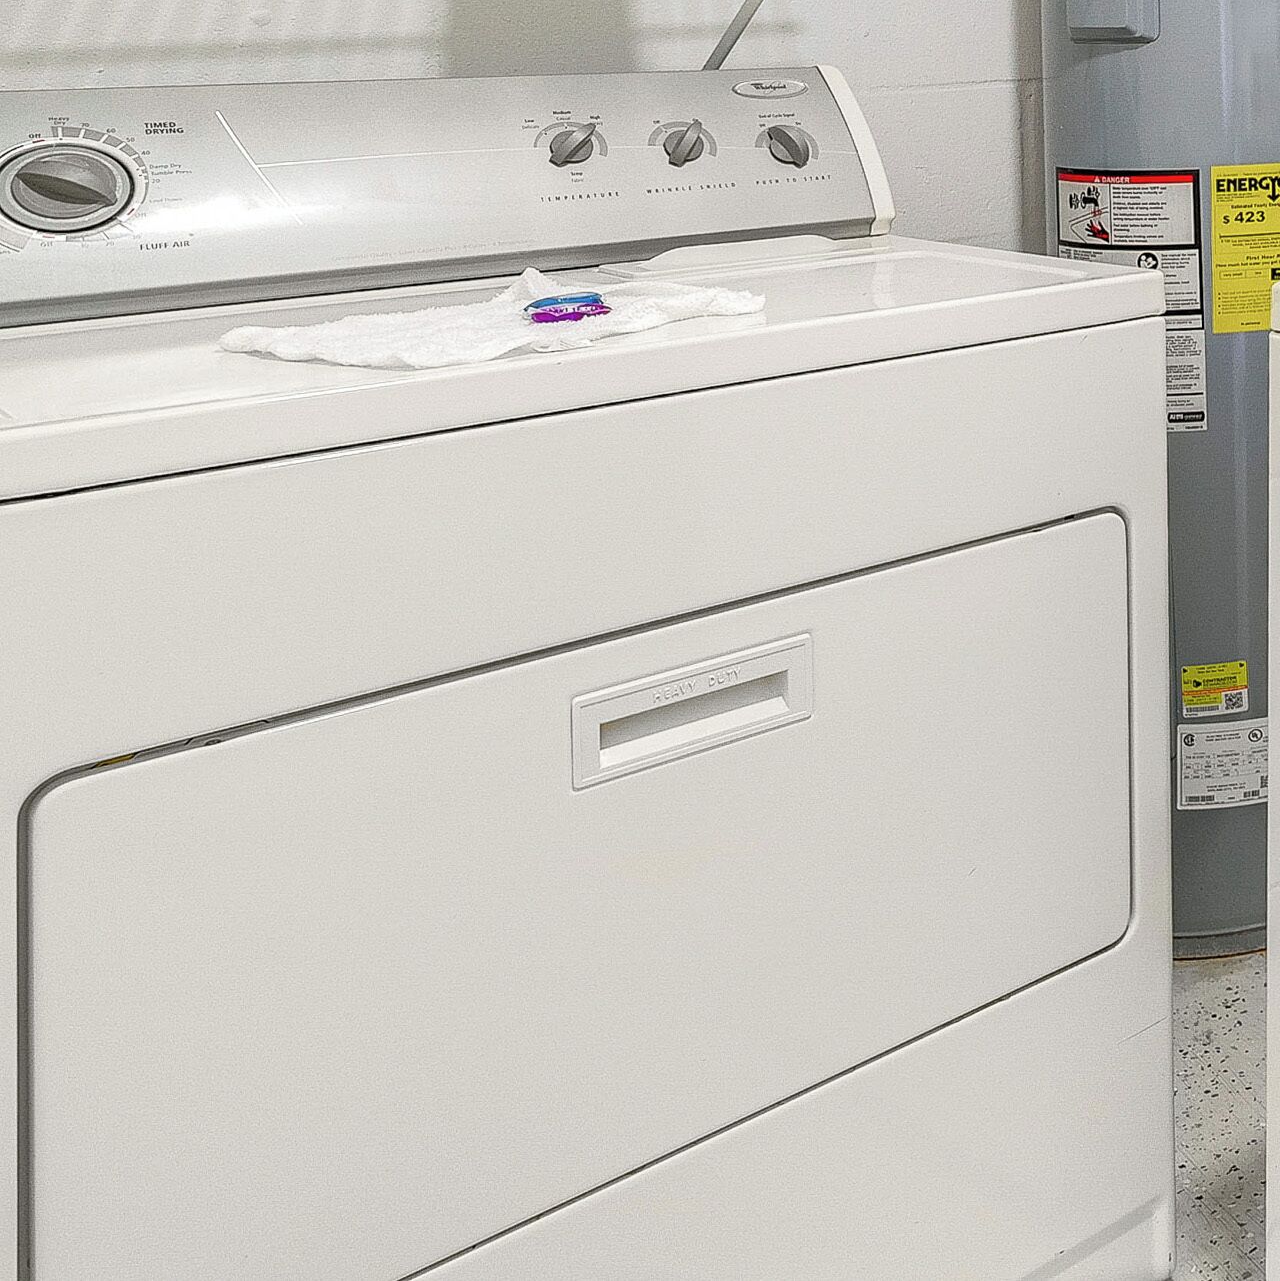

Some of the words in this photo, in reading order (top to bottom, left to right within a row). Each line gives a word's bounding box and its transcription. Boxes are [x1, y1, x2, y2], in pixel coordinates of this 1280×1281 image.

[646, 184, 692, 194] WRINKLE
[541, 192, 619, 202] TEMPERATURE
[1234, 211, 1265, 223] 423
[139, 242, 169, 250] FLUFF
[653, 680, 696, 704] HEAVY
[708, 666, 742, 687] DUTY
